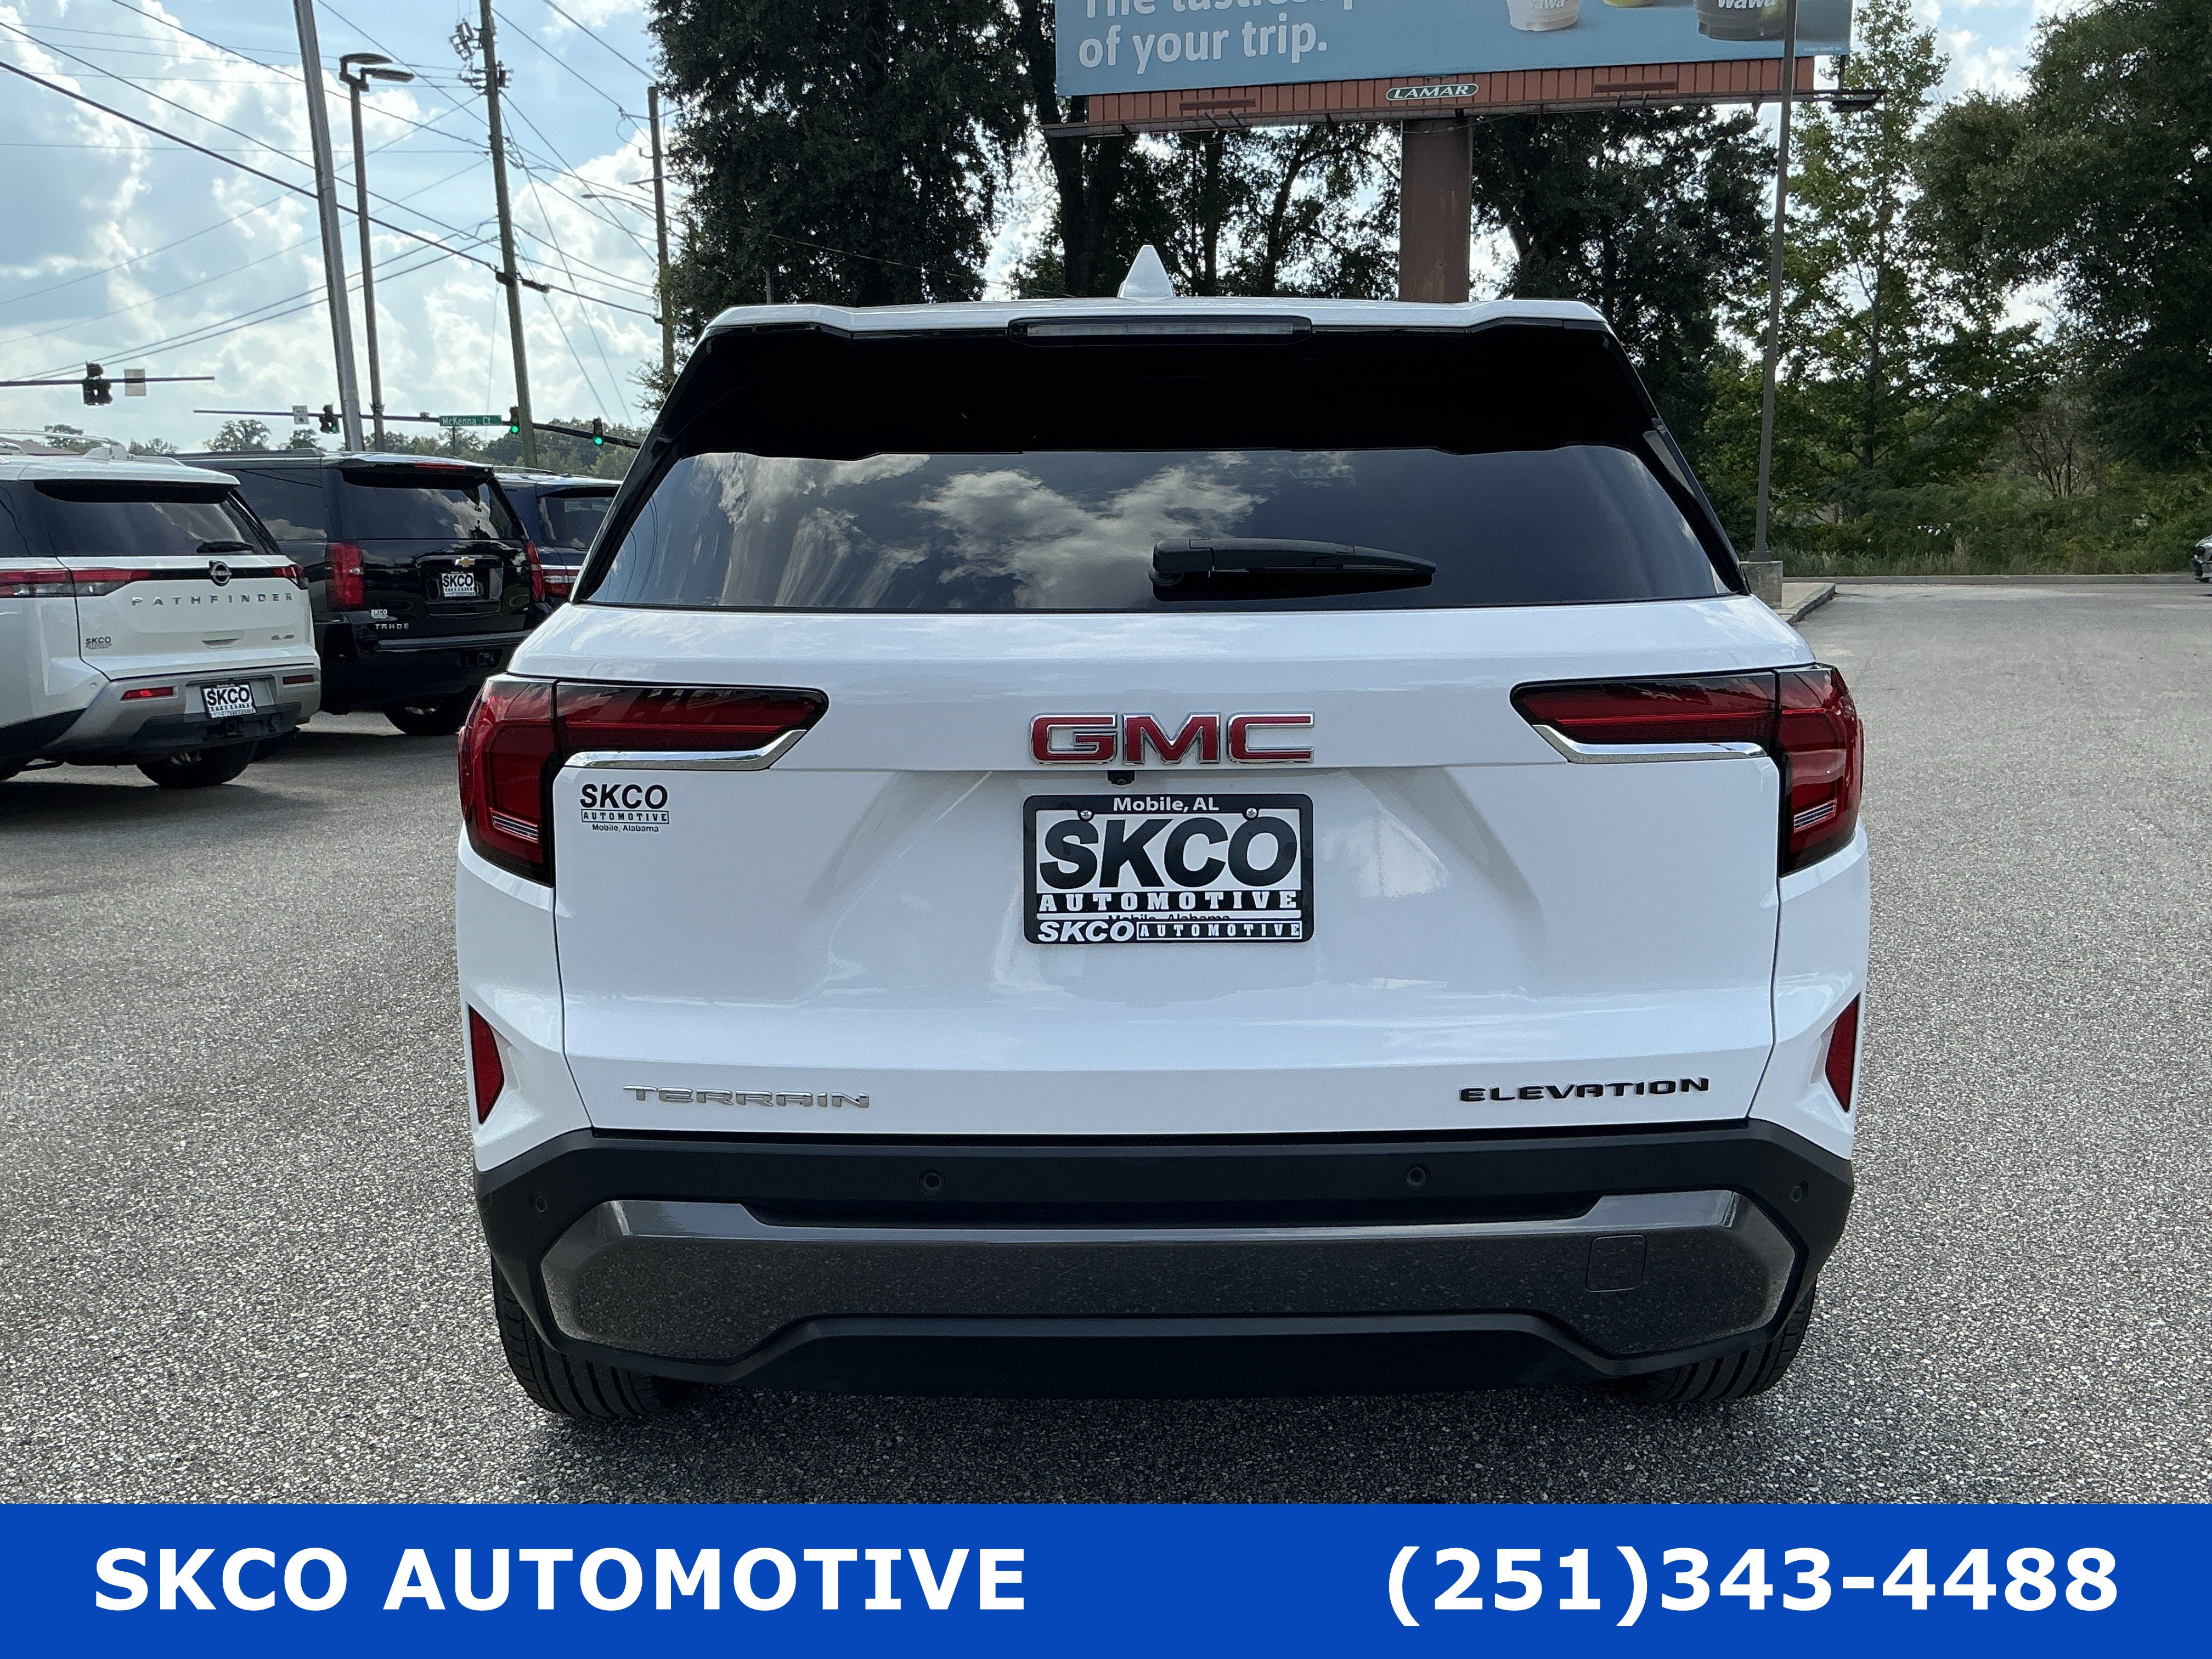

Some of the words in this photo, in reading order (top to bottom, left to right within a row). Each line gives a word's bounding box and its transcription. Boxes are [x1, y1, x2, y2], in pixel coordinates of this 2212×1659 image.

[1079, 25, 1121, 68] of
[1132, 31, 1229, 75] your
[1242, 13, 1328, 64] trip.
[1393, 86, 1469, 99] LAMAR
[442, 416, 477, 426] McKenna
[483, 416, 491, 425] Ct
[443, 574, 473, 588] SKCO
[131, 592, 293, 606] PATHFINDER
[85, 636, 111, 645] SKCO
[207, 687, 250, 707] SKCO
[1029, 712, 1314, 764] GMC
[580, 783, 668, 809] SKCO
[1113, 797, 1189, 812] Mobile,
[1193, 798, 1220, 811] AL
[583, 812, 668, 821] AUTOMOTIVE
[592, 824, 621, 832] Mobile,
[1039, 817, 1297, 890] SKCO
[1039, 890, 1296, 912] AUTOMOTIVE
[1037, 921, 1135, 942] SKCO
[1139, 923, 1301, 937] AUTOMOTIVE
[622, 1085, 870, 1108] TERRAIN
[1459, 1077, 1710, 1102] ELEVATION
